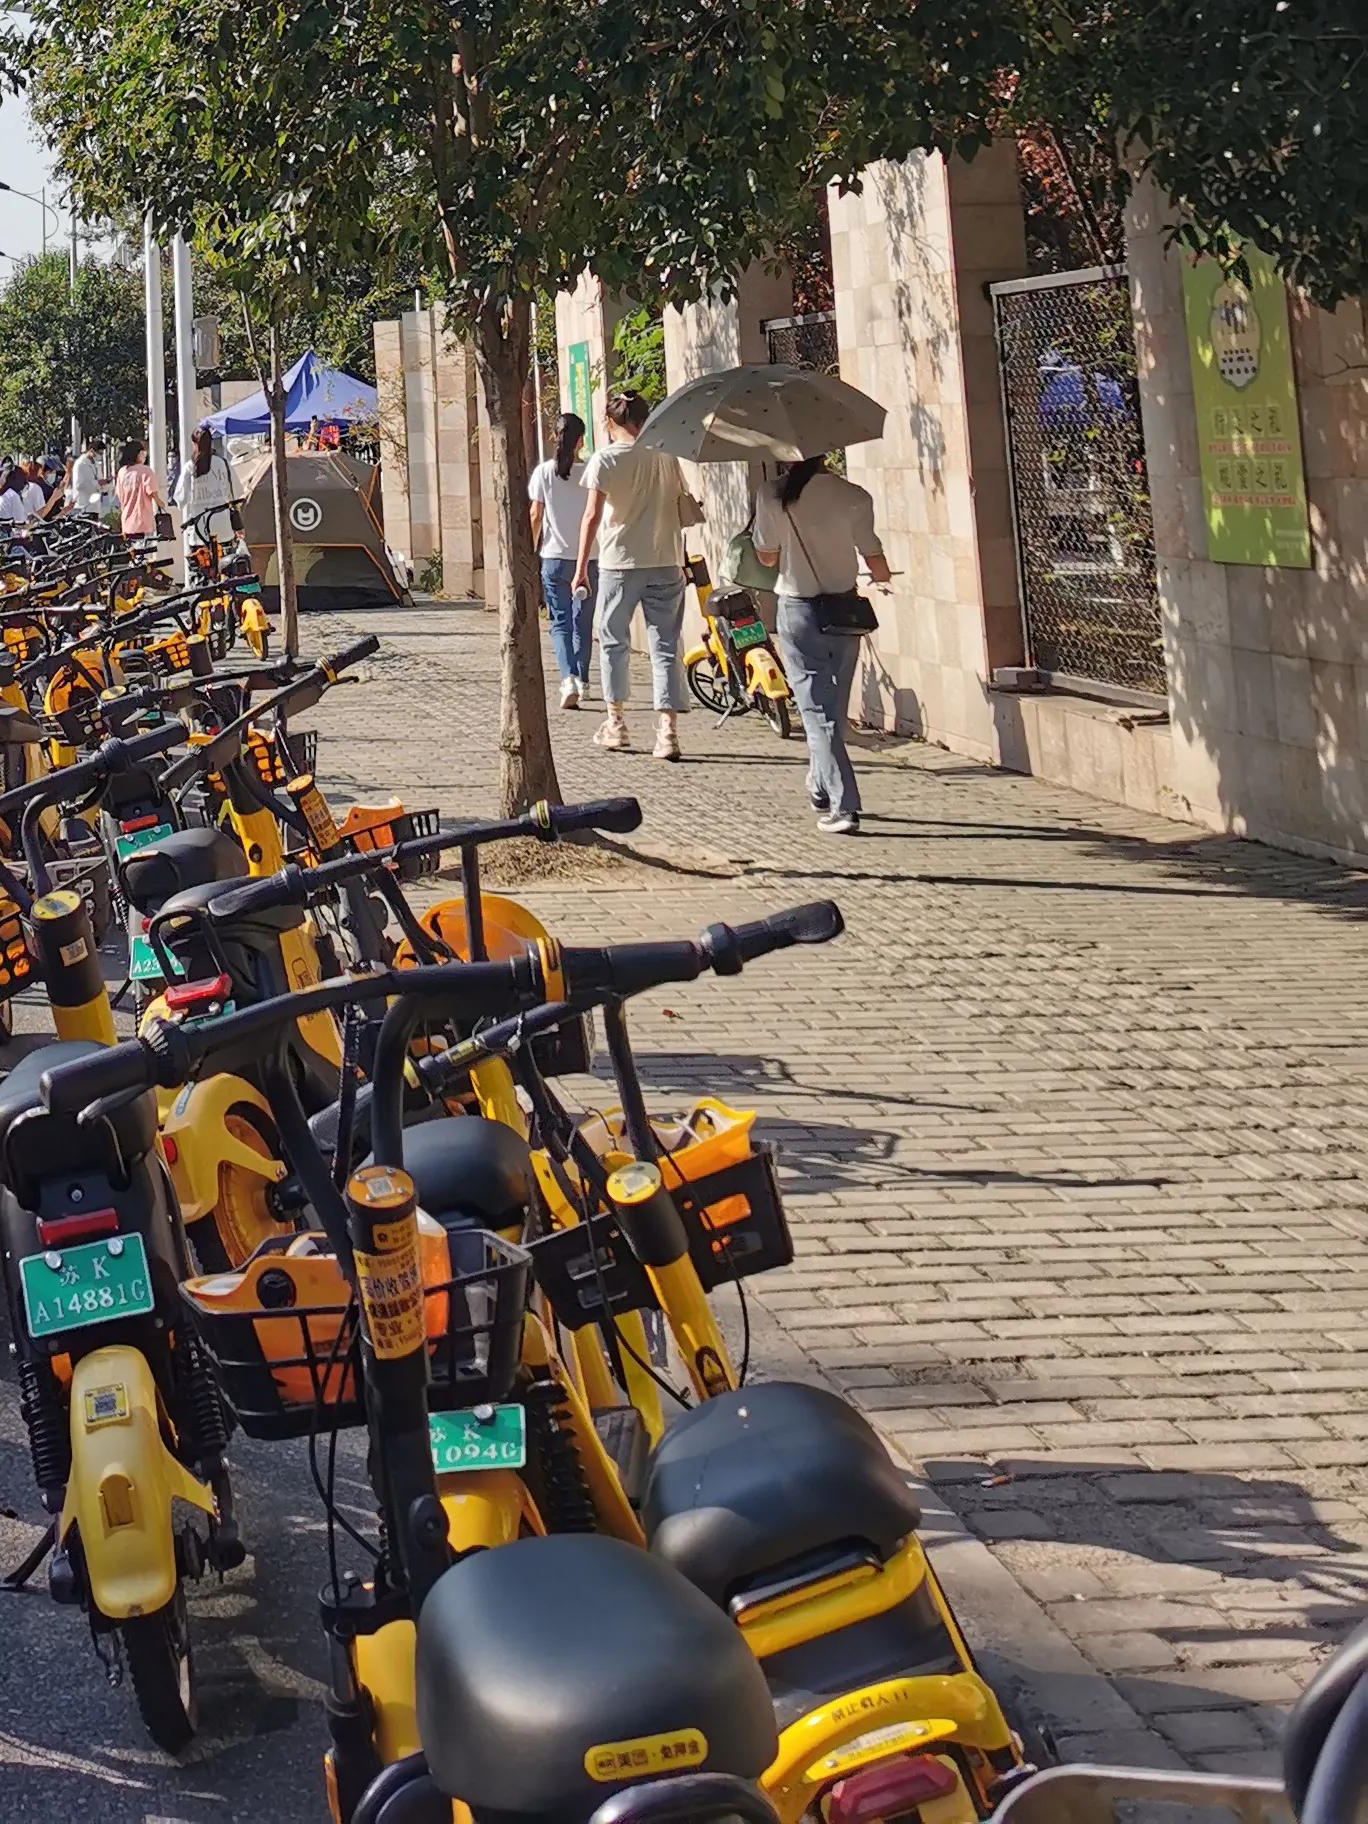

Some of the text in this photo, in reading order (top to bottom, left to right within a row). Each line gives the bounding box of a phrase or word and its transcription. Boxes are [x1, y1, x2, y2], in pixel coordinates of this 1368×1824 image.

[91, 1255, 112, 1280] K
[33, 1279, 145, 1325] A14881G
[431, 1441, 518, 1465] 1094G
